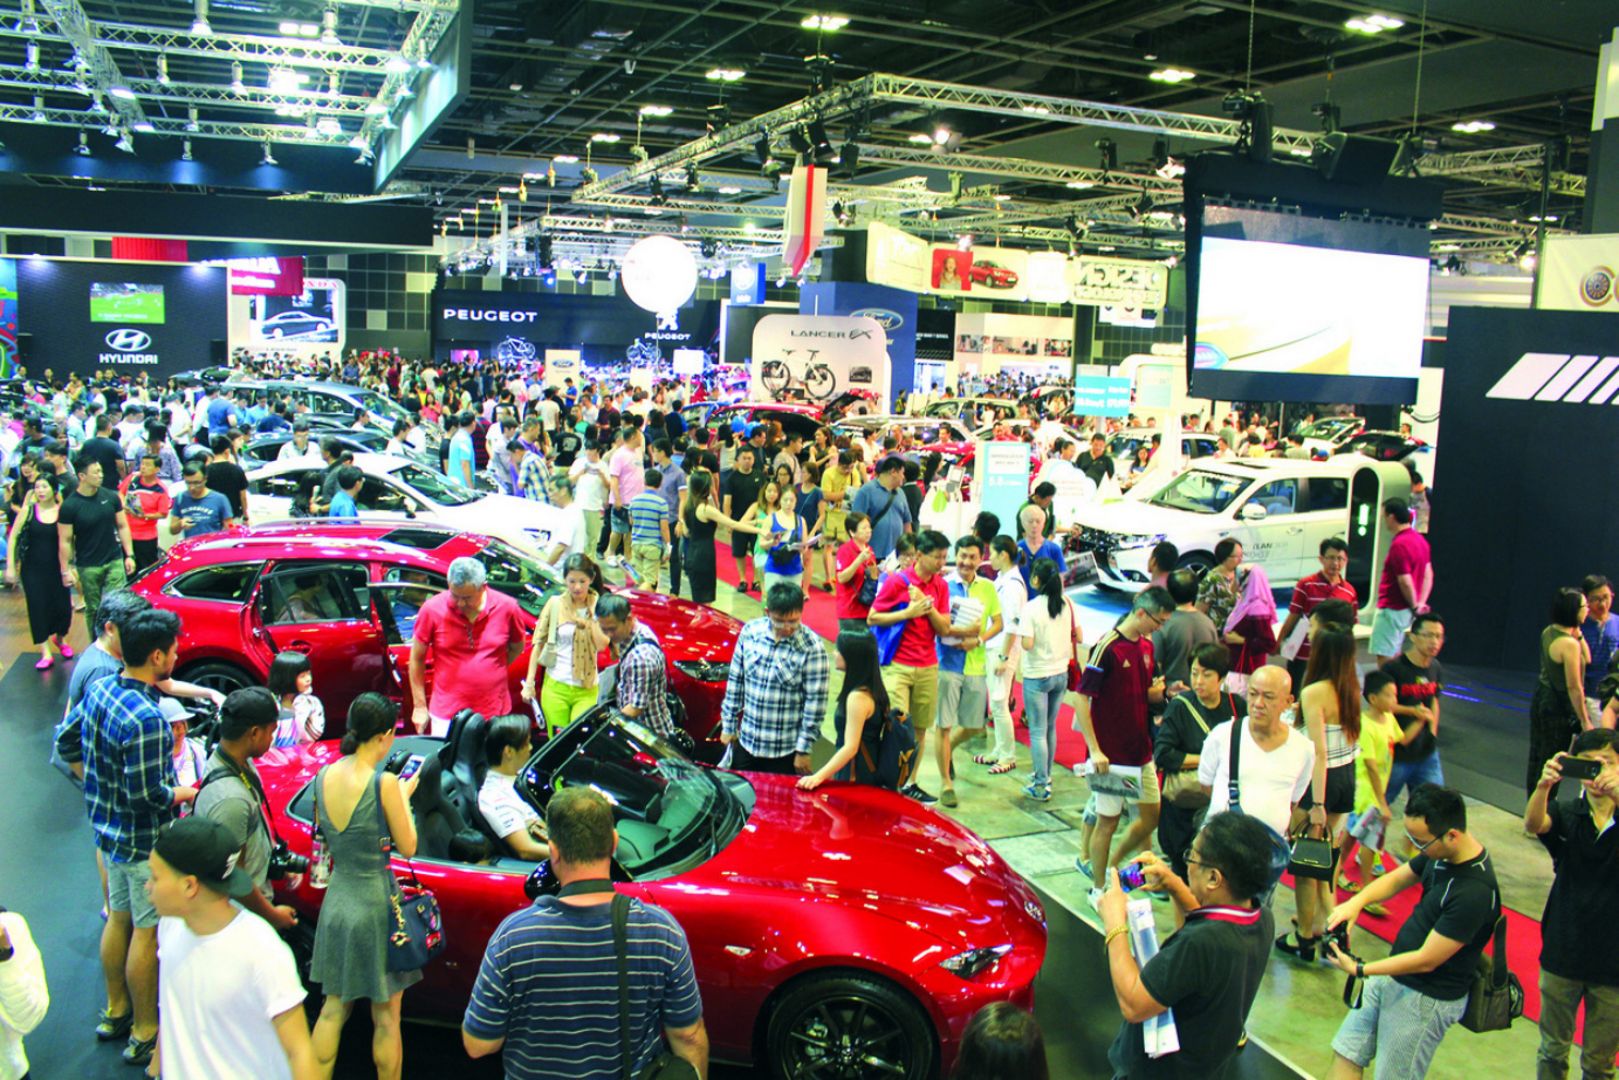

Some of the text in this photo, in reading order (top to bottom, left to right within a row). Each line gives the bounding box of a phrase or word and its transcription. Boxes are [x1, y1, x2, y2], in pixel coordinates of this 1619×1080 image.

[443, 308, 538, 322] PEUGEOT
[644, 332, 691, 340] PEUGEOT
[790, 330, 846, 338] LANCER
[99, 353, 158, 364] HYUNDAI
